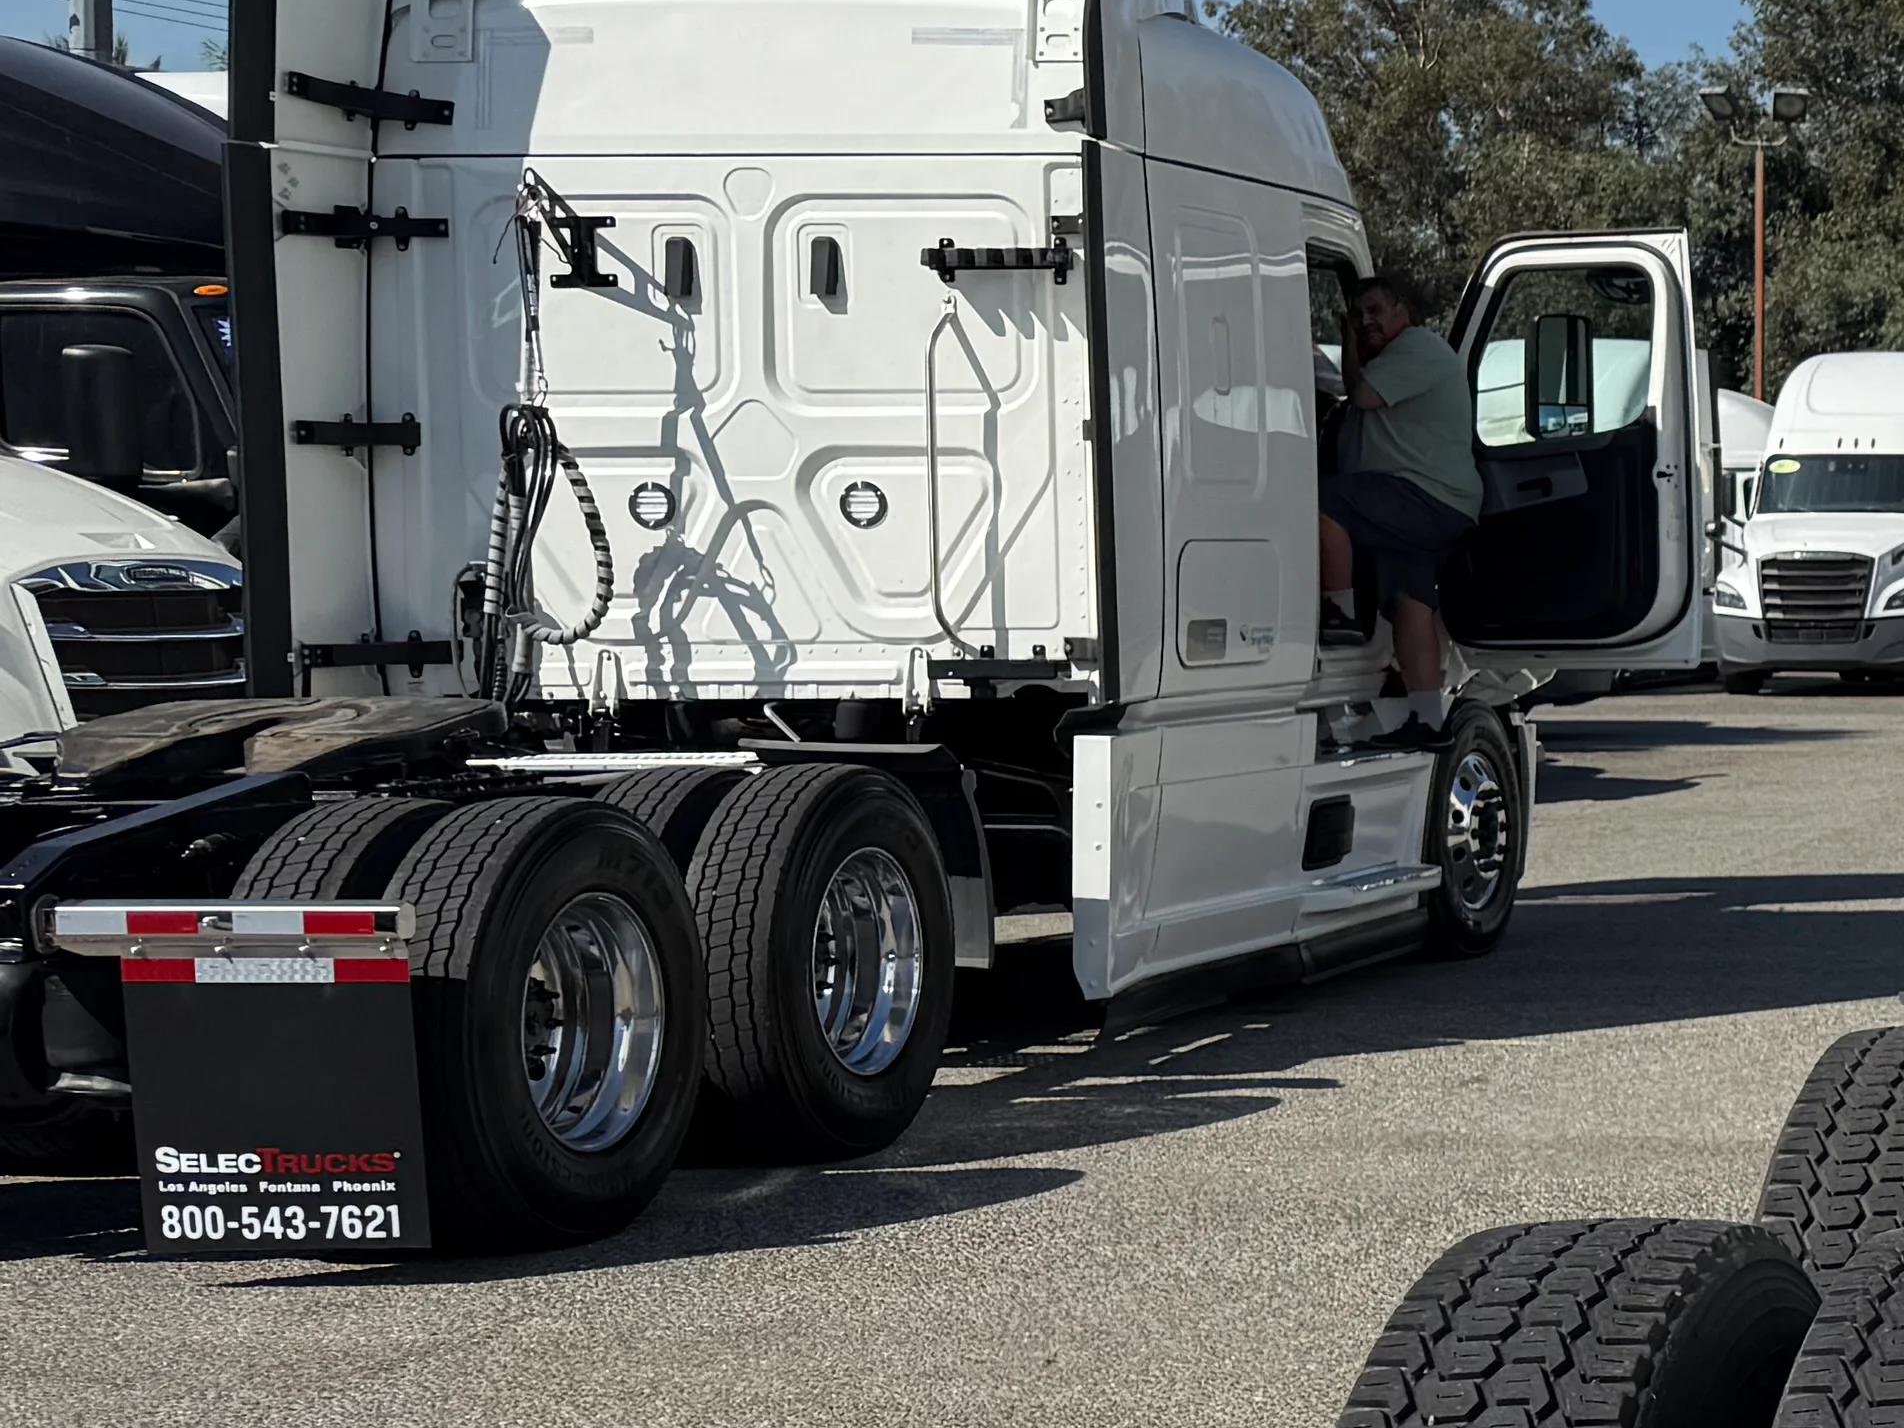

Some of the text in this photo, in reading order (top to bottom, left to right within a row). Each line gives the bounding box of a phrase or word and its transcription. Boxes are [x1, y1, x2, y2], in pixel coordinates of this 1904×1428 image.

[158, 1179, 396, 1196] Los Angeles Fontana Phoenix
[160, 1204, 401, 1240] 800-543-7621
